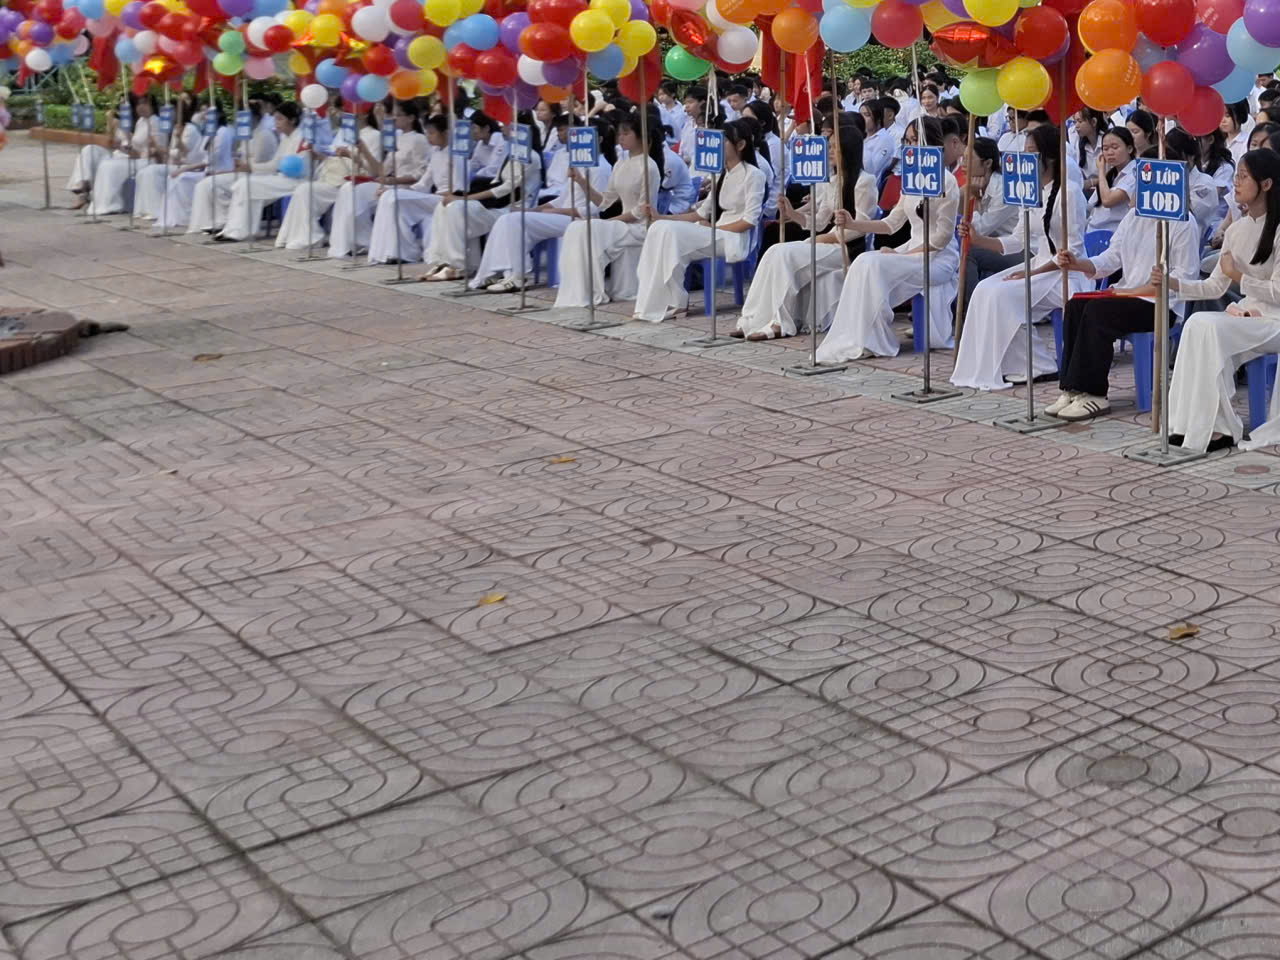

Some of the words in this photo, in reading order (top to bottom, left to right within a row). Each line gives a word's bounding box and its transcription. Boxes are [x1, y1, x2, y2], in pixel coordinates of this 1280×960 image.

[805, 140, 823, 156] LỚP
[795, 160, 823, 177] 10H
[1156, 167, 1180, 186] LỚP
[905, 172, 938, 191] 10G
[1008, 180, 1036, 201] 10E
